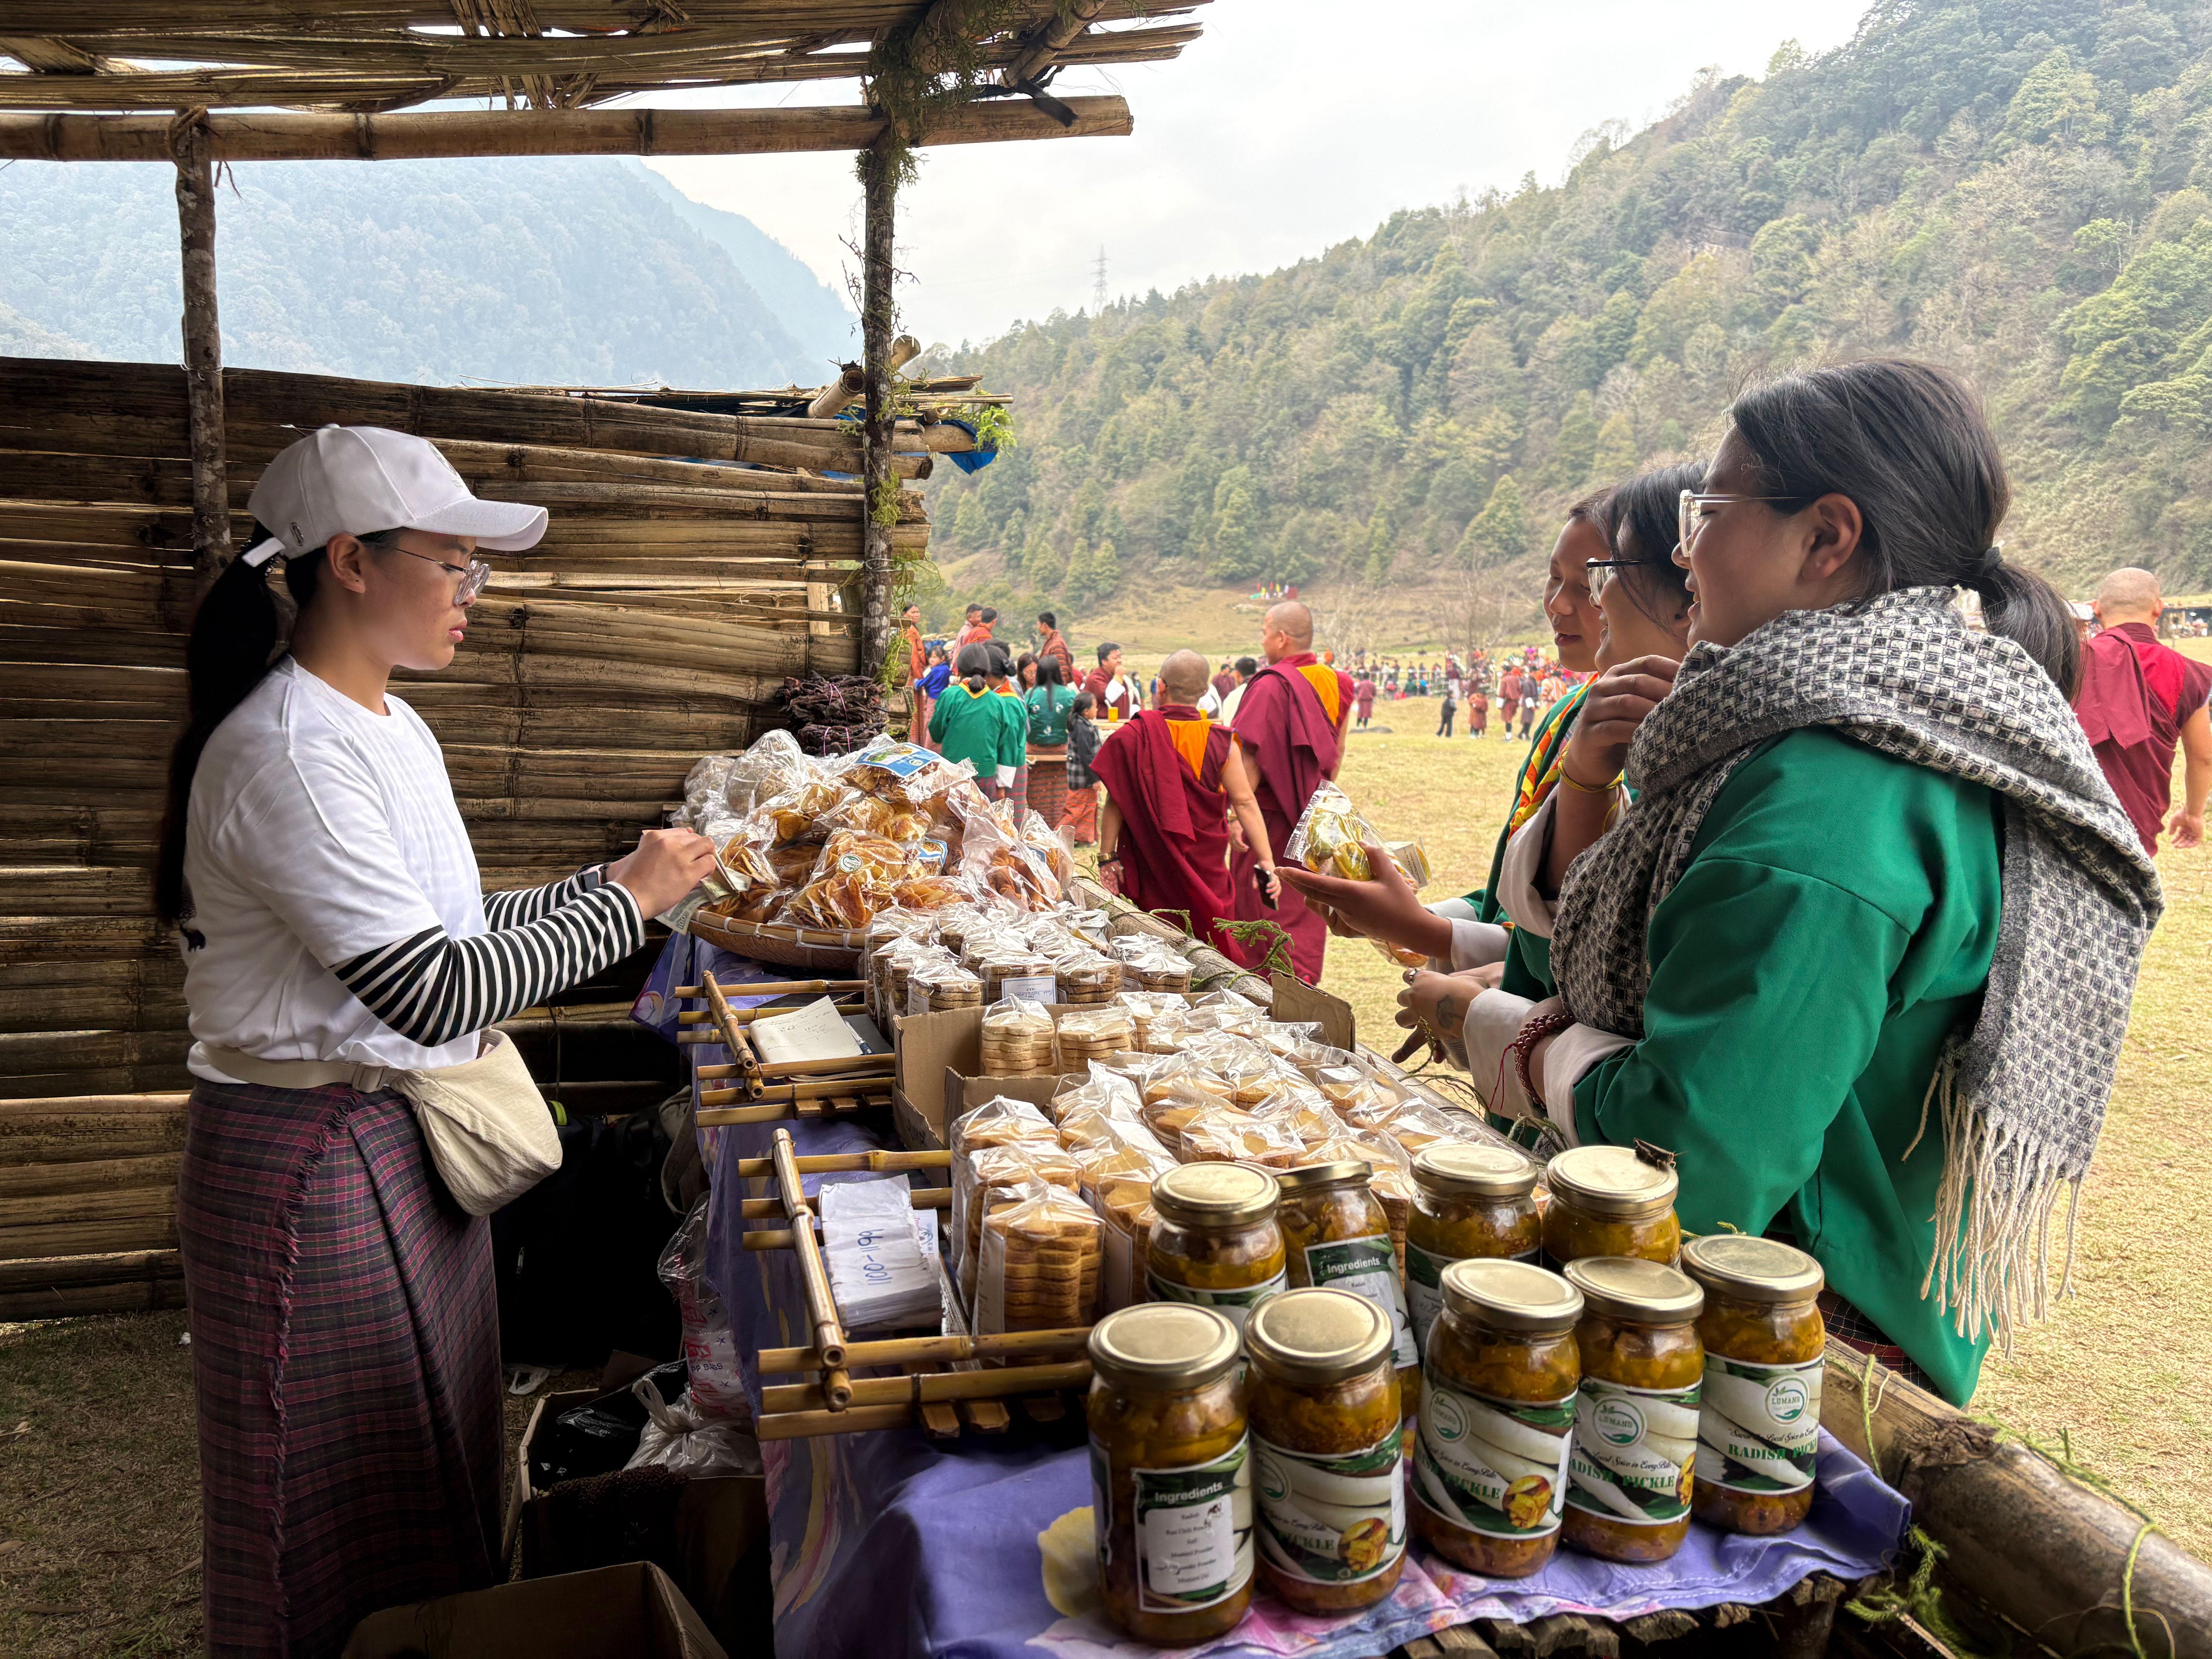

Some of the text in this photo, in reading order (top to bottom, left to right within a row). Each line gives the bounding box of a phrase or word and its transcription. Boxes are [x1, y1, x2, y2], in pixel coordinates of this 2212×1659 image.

[676, 916, 687, 929] 100
[1327, 1256, 1380, 1274] Ingredients
[704, 1362, 723, 1371] BAGS
[1728, 1443, 1786, 1460] RADISH
[1570, 1458, 1675, 1489] ADISH PICKLE
[1154, 1481, 1223, 1504] Ingredients
